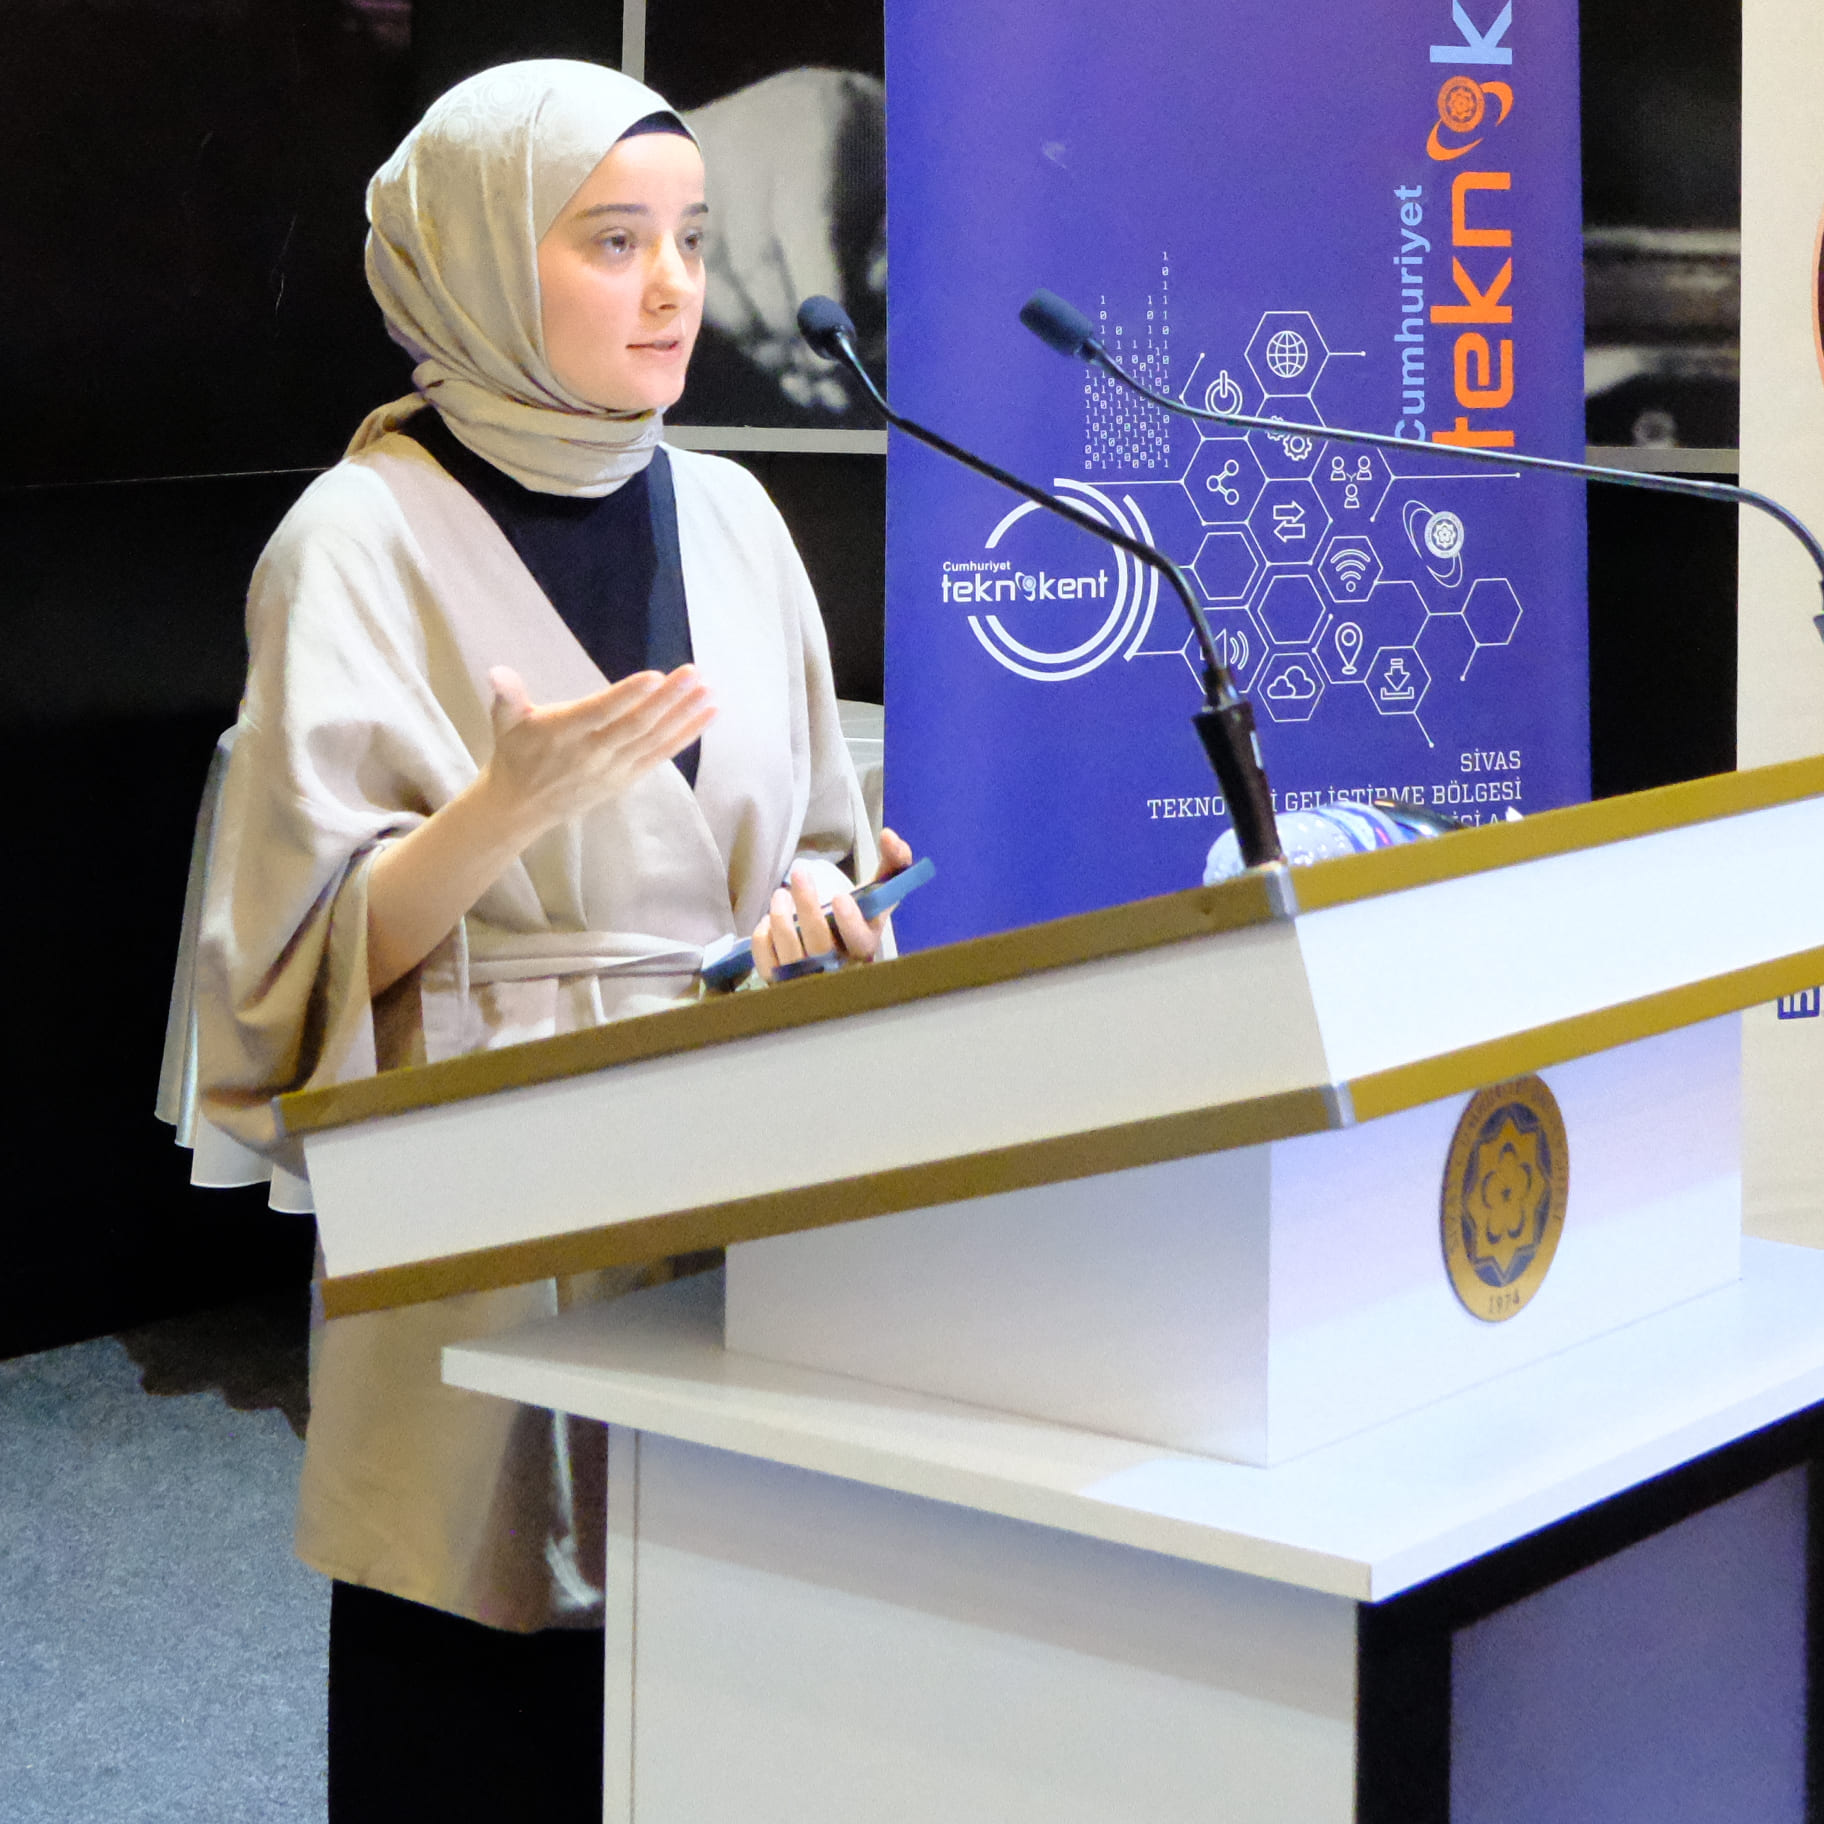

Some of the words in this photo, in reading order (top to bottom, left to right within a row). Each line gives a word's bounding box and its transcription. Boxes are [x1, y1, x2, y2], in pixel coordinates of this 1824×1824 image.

[1394, 184, 1431, 442] Cumhuriyet
[942, 560, 1011, 573] Cumhuriyet
[1460, 748, 1521, 773] SİVAS
[1147, 788, 1278, 819] TEKNOİ
[1431, 776, 1522, 804] BÖLGESİ
